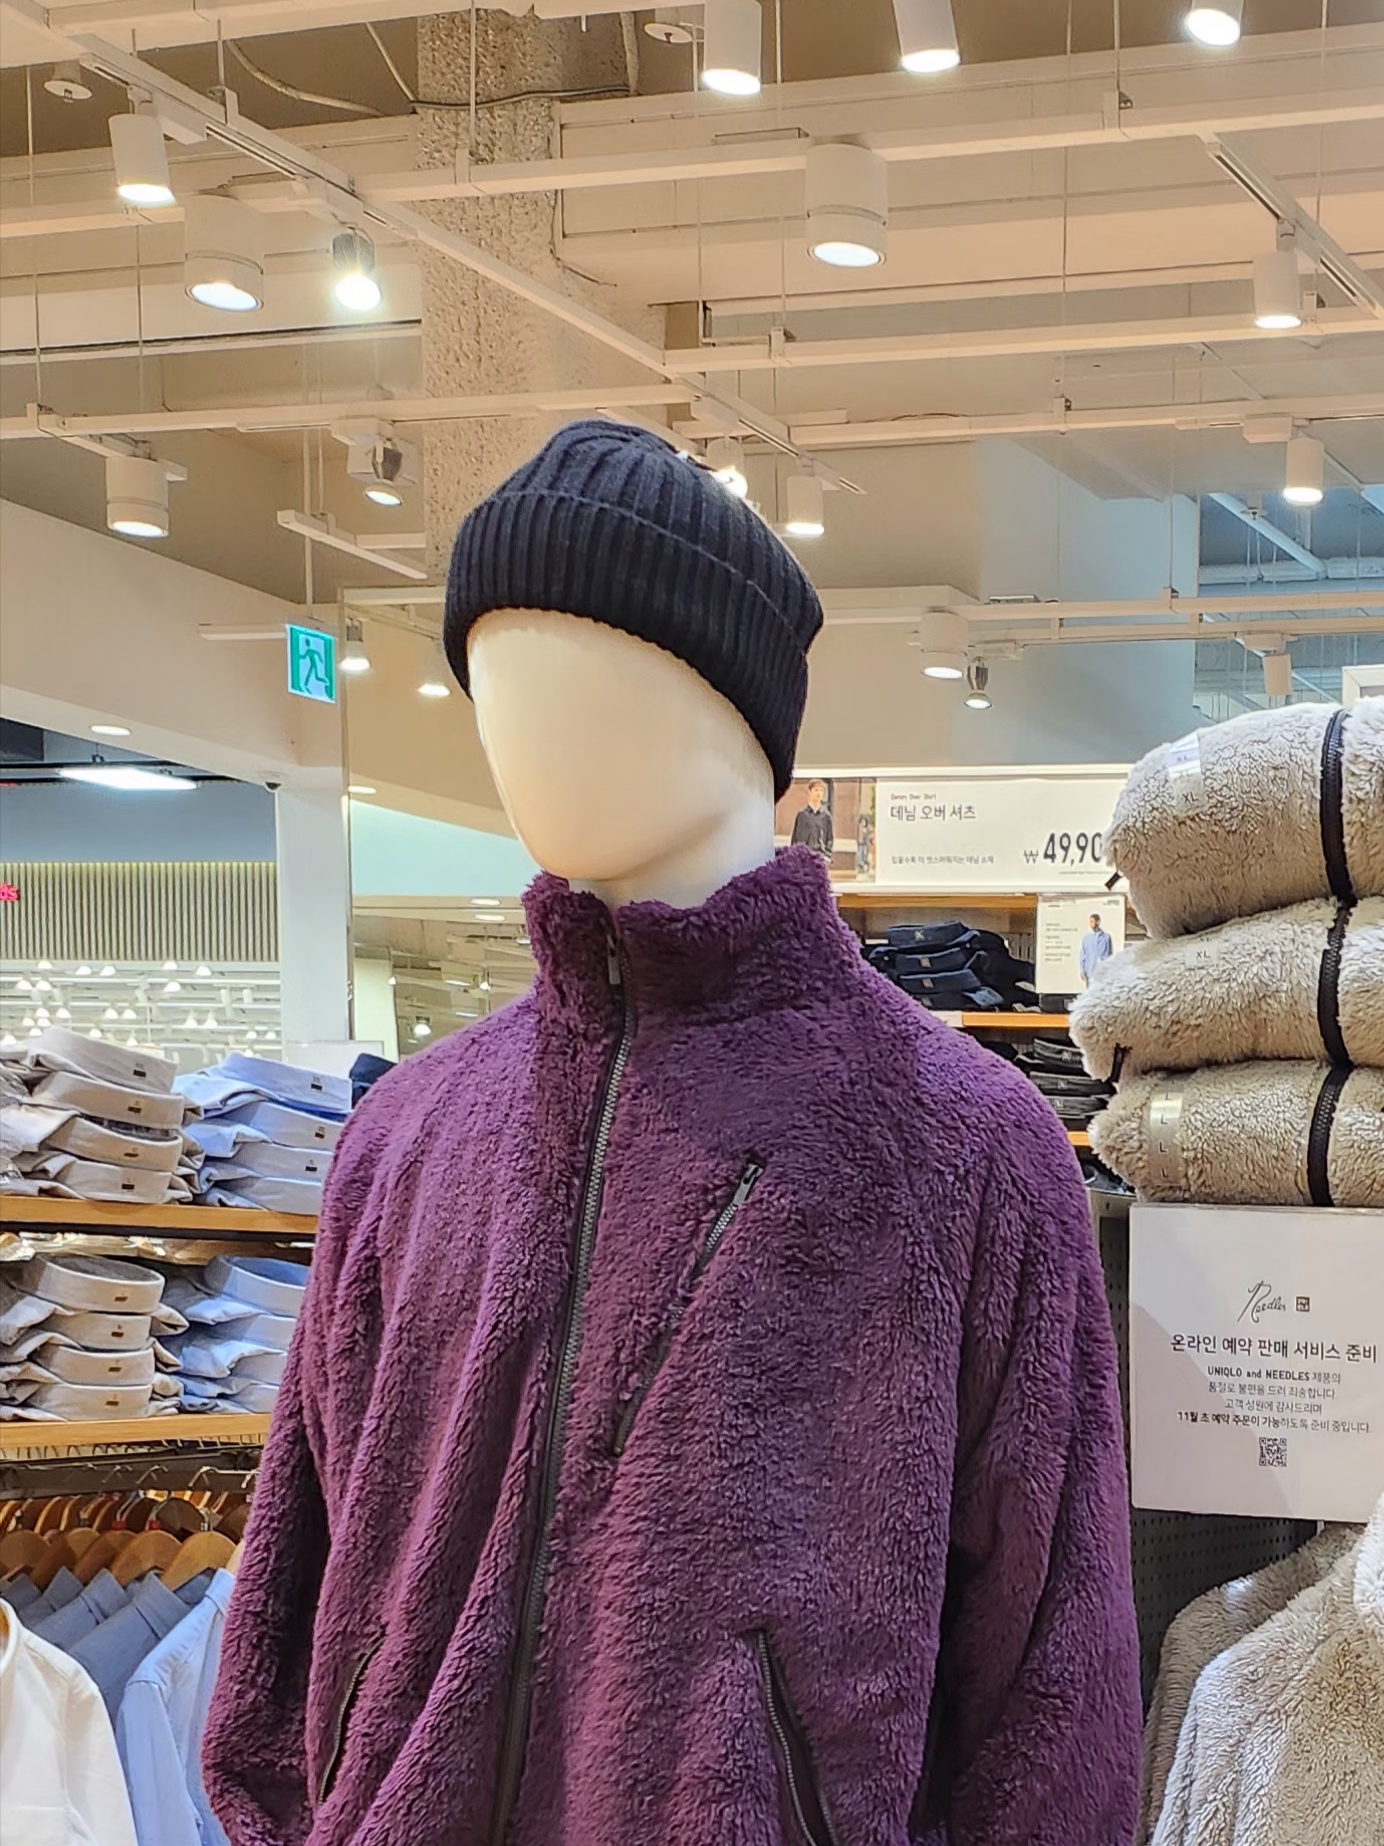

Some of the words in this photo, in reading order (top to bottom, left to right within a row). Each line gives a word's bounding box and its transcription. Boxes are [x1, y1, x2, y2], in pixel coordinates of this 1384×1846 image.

[890, 804, 917, 821] 데님
[920, 804, 945, 821] 오버
[949, 804, 976, 821] 셔츠
[1160, 1142, 1167, 1153] L
[1171, 1334, 1216, 1354] 온라인
[1222, 1337, 1253, 1357] 예약
[1257, 1339, 1288, 1358] 판매
[1293, 1341, 1341, 1360] 서비스
[1345, 1344, 1377, 1364] 준비
[1207, 1366, 1243, 1378] UNIQLO
[1247, 1369, 1262, 1378] and
[1265, 1370, 1310, 1381] NEEDLES
[1312, 1372, 1341, 1384] 제품의
[1209, 1381, 1236, 1394] 품절로
[1238, 1383, 1265, 1396] 불편을
[1267, 1386, 1286, 1397] 드려
[1224, 1398, 1244, 1410] 고객
[1246, 1399, 1273, 1411] 성원에
[1275, 1401, 1322, 1415] 감사드리며
[1177, 1411, 1199, 1423] 11월
[1200, 1412, 1210, 1423] 초
[1211, 1413, 1231, 1425] 예약
[1232, 1414, 1260, 1427] 주문이
[1262, 1416, 1309, 1430] 가능하도록
[1310, 1419, 1330, 1432] 준비
